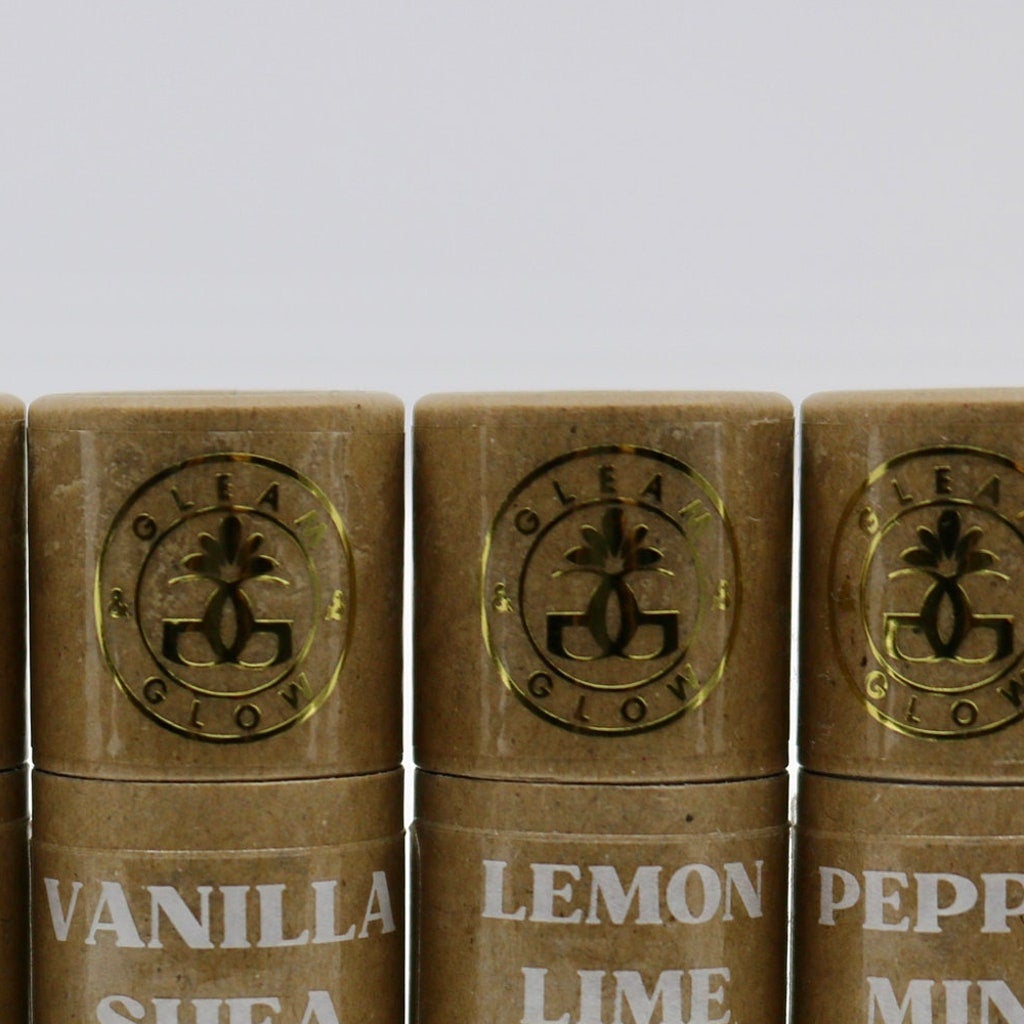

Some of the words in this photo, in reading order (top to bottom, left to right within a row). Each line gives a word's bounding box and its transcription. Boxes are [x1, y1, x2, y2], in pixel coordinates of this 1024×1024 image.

[133, 473, 326, 546] GLEAM
[514, 464, 711, 538] GLEAM
[859, 465, 1024, 535] GLEA
[143, 672, 312, 730] GLOW
[527, 663, 699, 723] GLOW
[44, 871, 394, 949] VANILLA
[482, 860, 764, 925] LEMON
